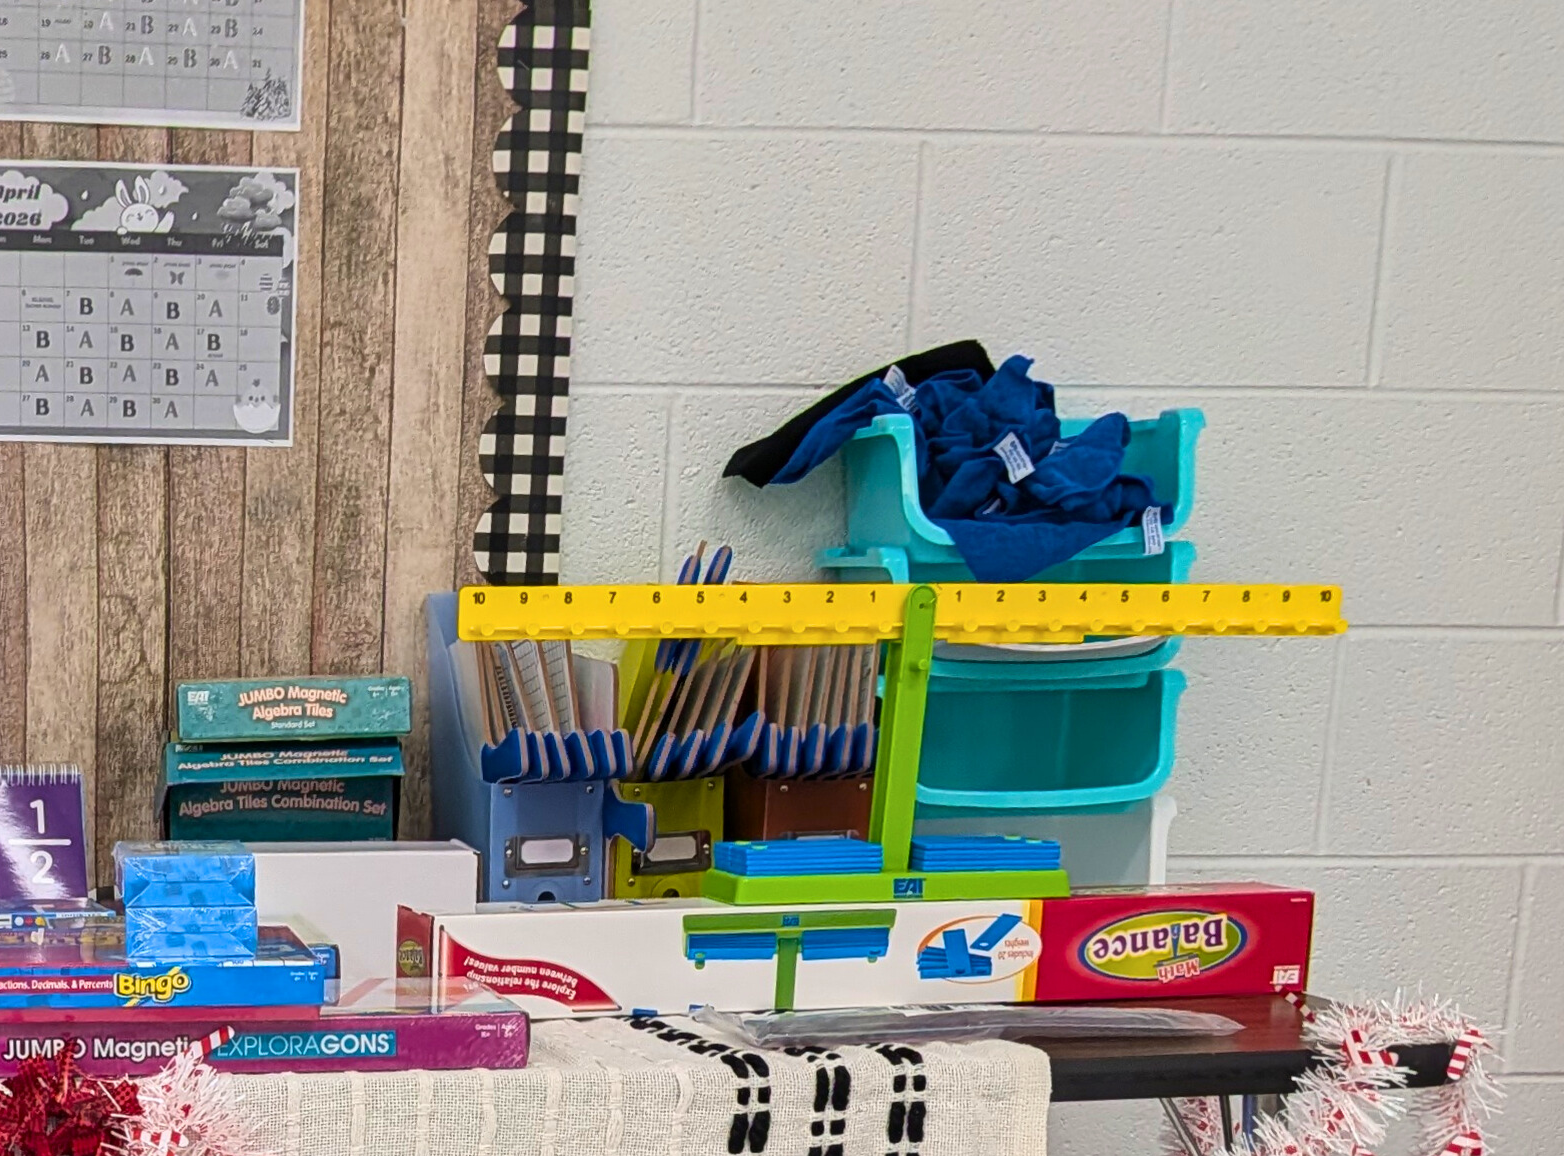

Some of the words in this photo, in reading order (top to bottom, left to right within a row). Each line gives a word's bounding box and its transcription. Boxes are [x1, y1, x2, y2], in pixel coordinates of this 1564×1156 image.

[99, 12, 114, 31] A
[141, 15, 154, 34] B
[182, 17, 197, 37] A
[225, 19, 238, 38] B
[55, 43, 71, 63] A
[98, 45, 112, 64] B
[139, 47, 154, 66] A
[184, 48, 197, 68] B
[224, 50, 239, 70] A
[80, 297, 93, 315] B
[120, 299, 135, 316] A
[166, 302, 180, 320] B
[208, 299, 223, 318] A
[472, 593, 486, 605] 10
[519, 593, 528, 605] 9
[563, 592, 573, 604] 8
[608, 592, 617, 604] 7
[652, 592, 661, 604] 6
[696, 592, 705, 604] 5
[739, 592, 748, 604] 4
[782, 592, 791, 604] 3
[825, 592, 834, 604] 2
[870, 591, 876, 603] 1
[955, 591, 962, 603] 1
[996, 591, 1005, 603] 2
[1038, 591, 1047, 603] 3
[1078, 591, 1088, 603] 4
[1121, 591, 1130, 603] 5
[1161, 591, 1170, 603] 6
[1202, 591, 1211, 603] 7
[1241, 591, 1250, 603] 8
[1282, 591, 1291, 603] 9
[1320, 591, 1332, 603] 10
[238, 686, 285, 707] JUMBO
[288, 686, 348, 704] Magnetic
[252, 704, 302, 721] Algebra
[305, 703, 334, 718] Tiles
[271, 720, 302, 729] Standard
[304, 720, 316, 728] Set
[177, 759, 234, 770] Algebra
[273, 756, 366, 765] Combination
[369, 755, 393, 763] Set
[220, 751, 274, 761] JUMBO
[279, 749, 348, 759] Magnetic
[220, 780, 274, 794] JUMBO
[278, 778, 345, 793] Magnetic
[179, 799, 234, 818] Algebra
[237, 796, 268, 810] Tiles
[271, 794, 360, 812] Combination
[363, 801, 387, 816] Set
[29, 799, 47, 834] 1
[29, 850, 55, 885] 2
[1004, 938, 1030, 949] weights
[1092, 918, 1224, 961] Balance
[463, 955, 499, 972] values!
[998, 950, 1006, 959] 20
[1008, 950, 1034, 960] Includes
[501, 965, 538, 977] number
[539, 967, 578, 988] between
[1157, 957, 1200, 983] Math
[71, 979, 79, 990] &
[80, 979, 113, 990] Percents
[118, 967, 189, 1001] Bingo
[524, 978, 540, 990] the
[541, 980, 577, 1000] Explore
[94, 1038, 202, 1062] Magneti
